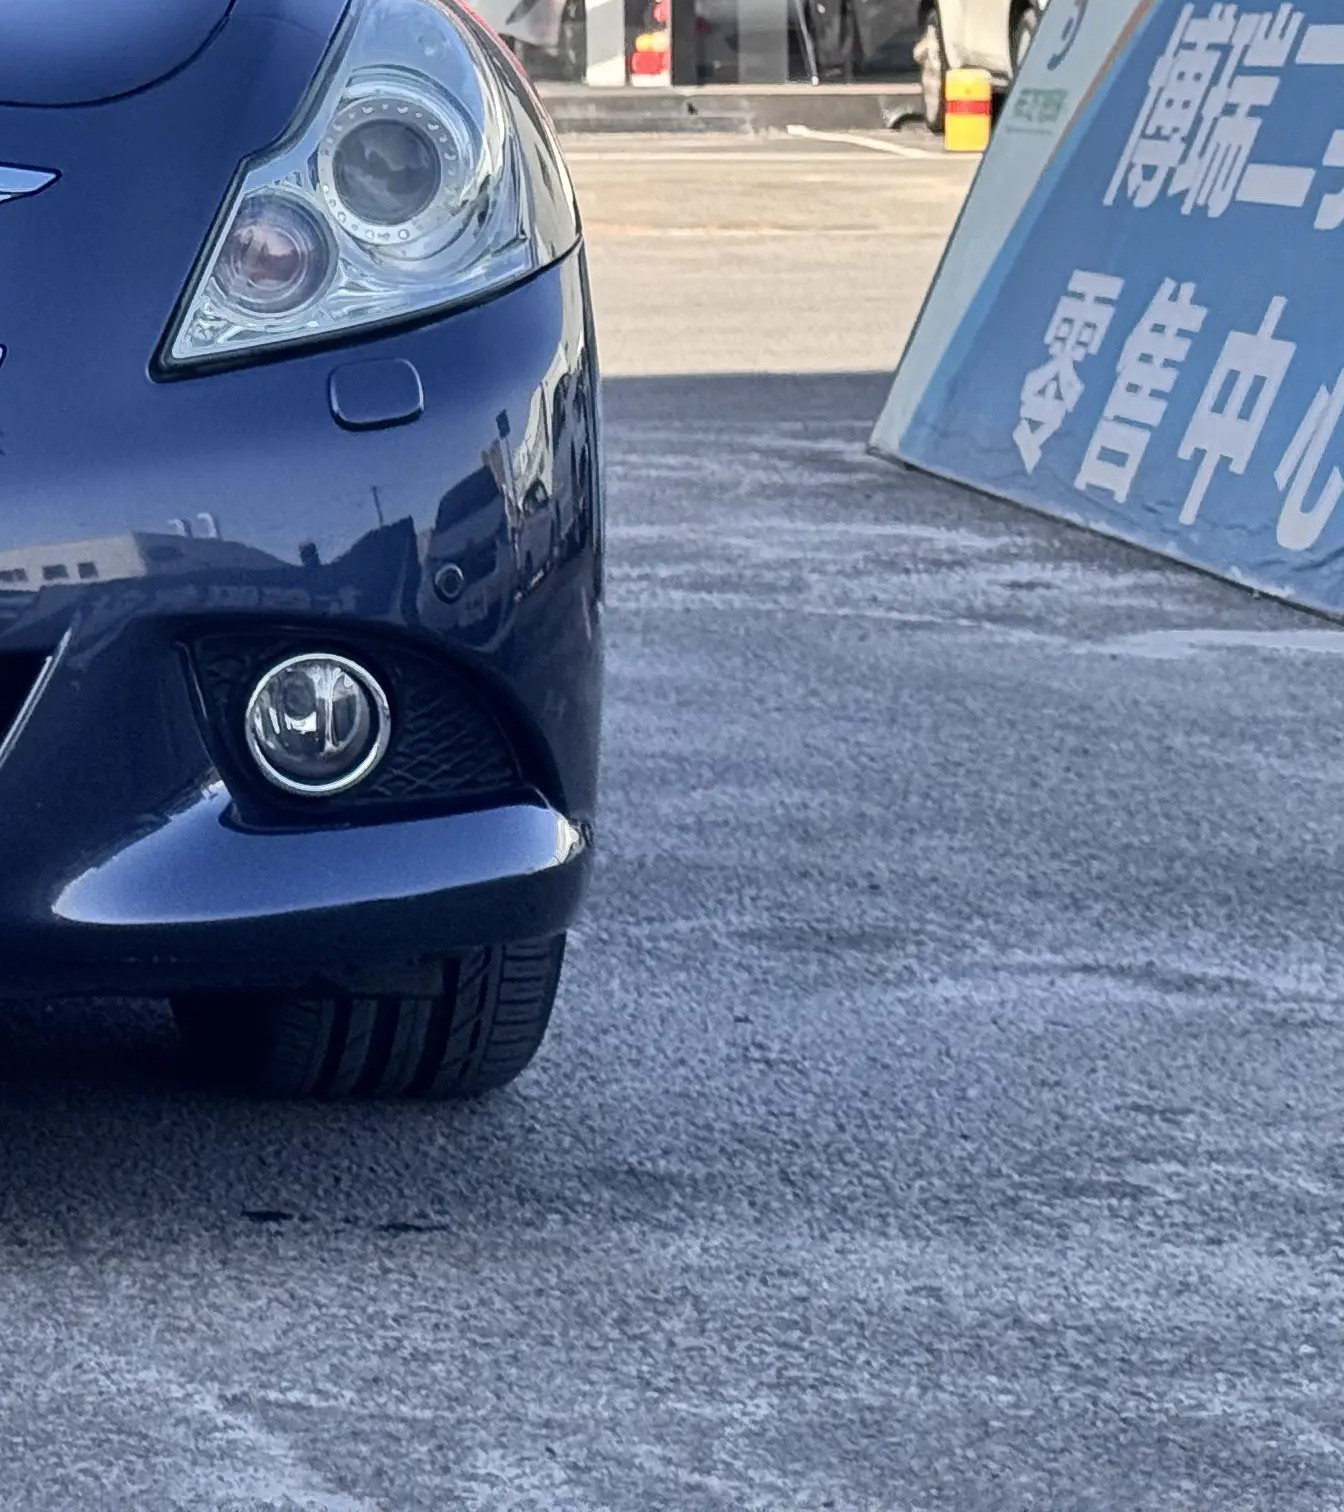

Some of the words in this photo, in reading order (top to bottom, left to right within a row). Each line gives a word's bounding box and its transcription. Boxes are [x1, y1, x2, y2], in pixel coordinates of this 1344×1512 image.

[1103, 2, 1344, 230] 博瑞二
[1012, 268, 1344, 552] 零售中心
